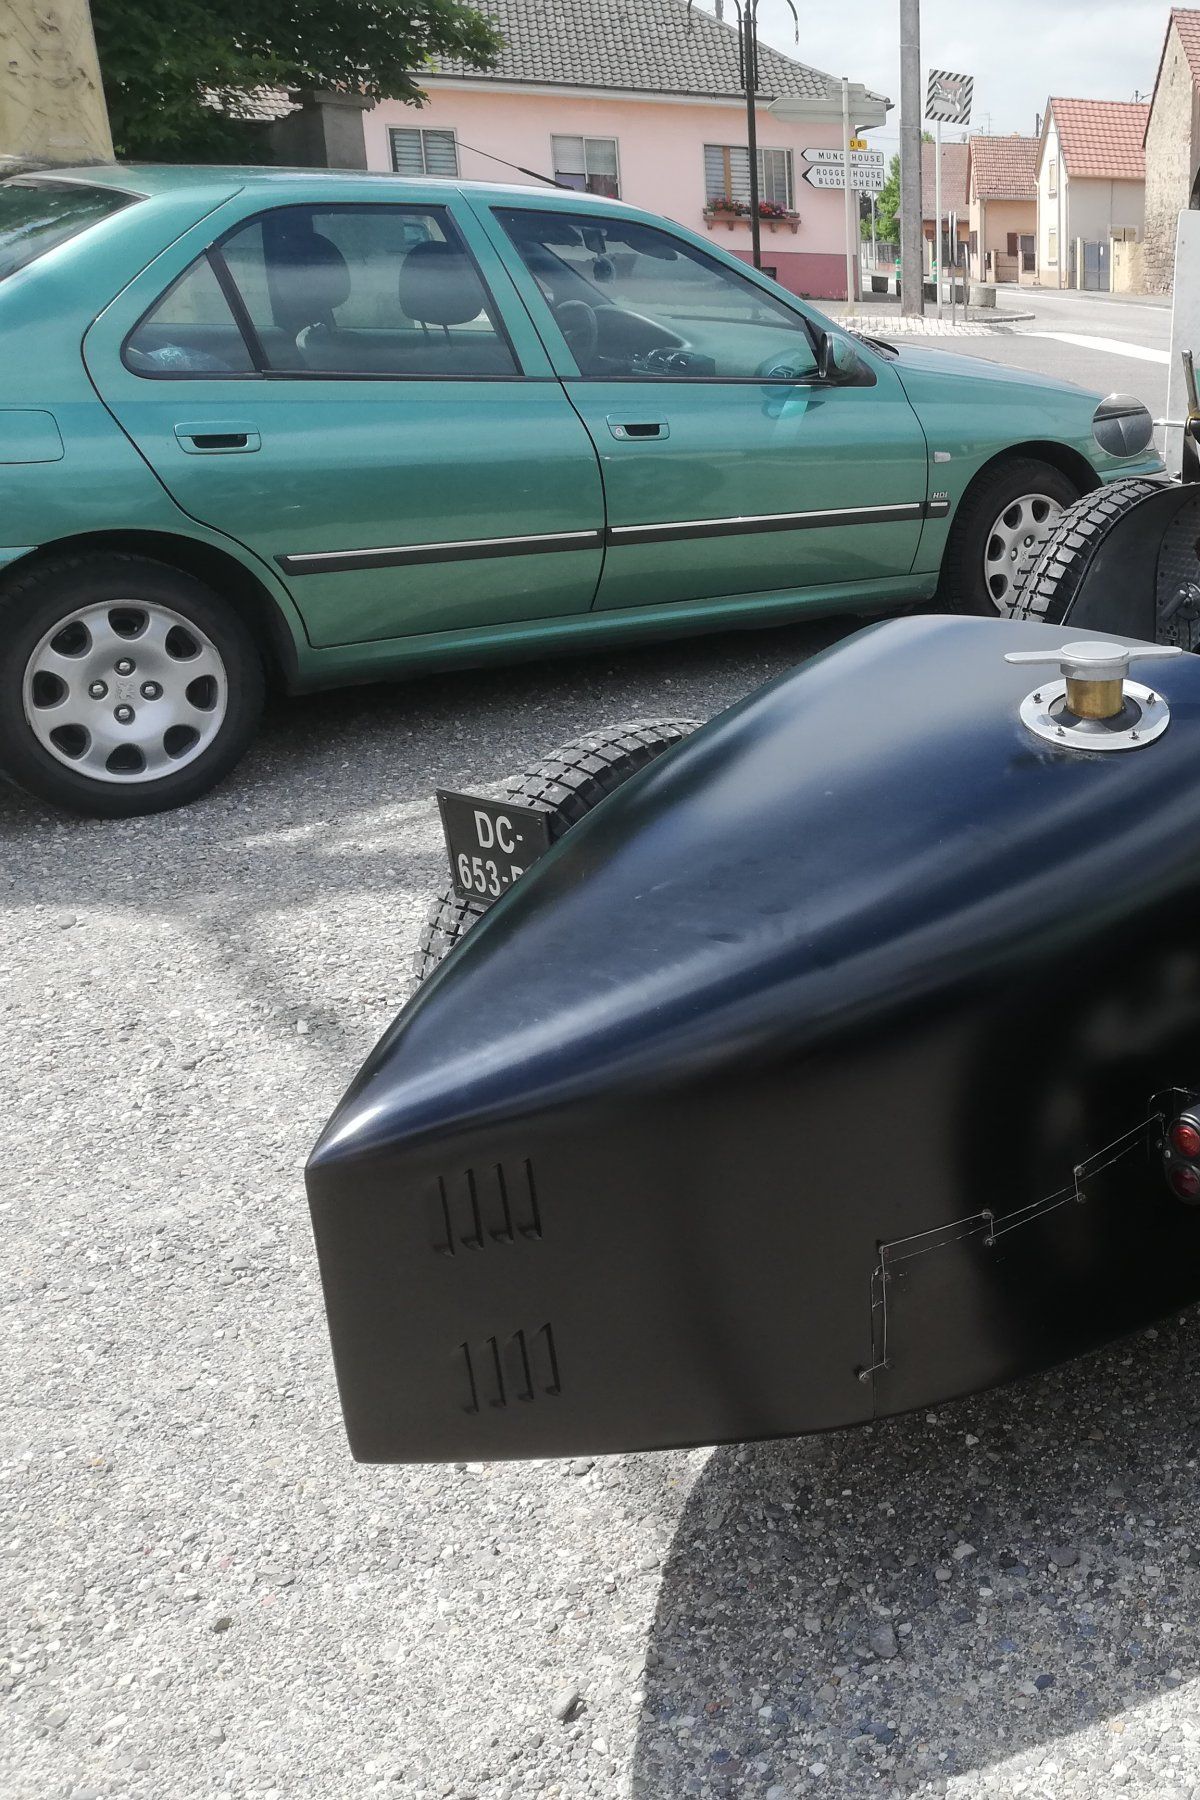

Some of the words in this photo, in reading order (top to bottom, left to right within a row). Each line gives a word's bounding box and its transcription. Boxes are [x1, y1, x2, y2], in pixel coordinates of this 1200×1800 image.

[818, 152, 881, 163] MUNCHOUSE
[816, 168, 881, 179] ROGGEHOUSE
[818, 177, 882, 188] BLODESHEIM
[474, 810, 523, 854] DC-
